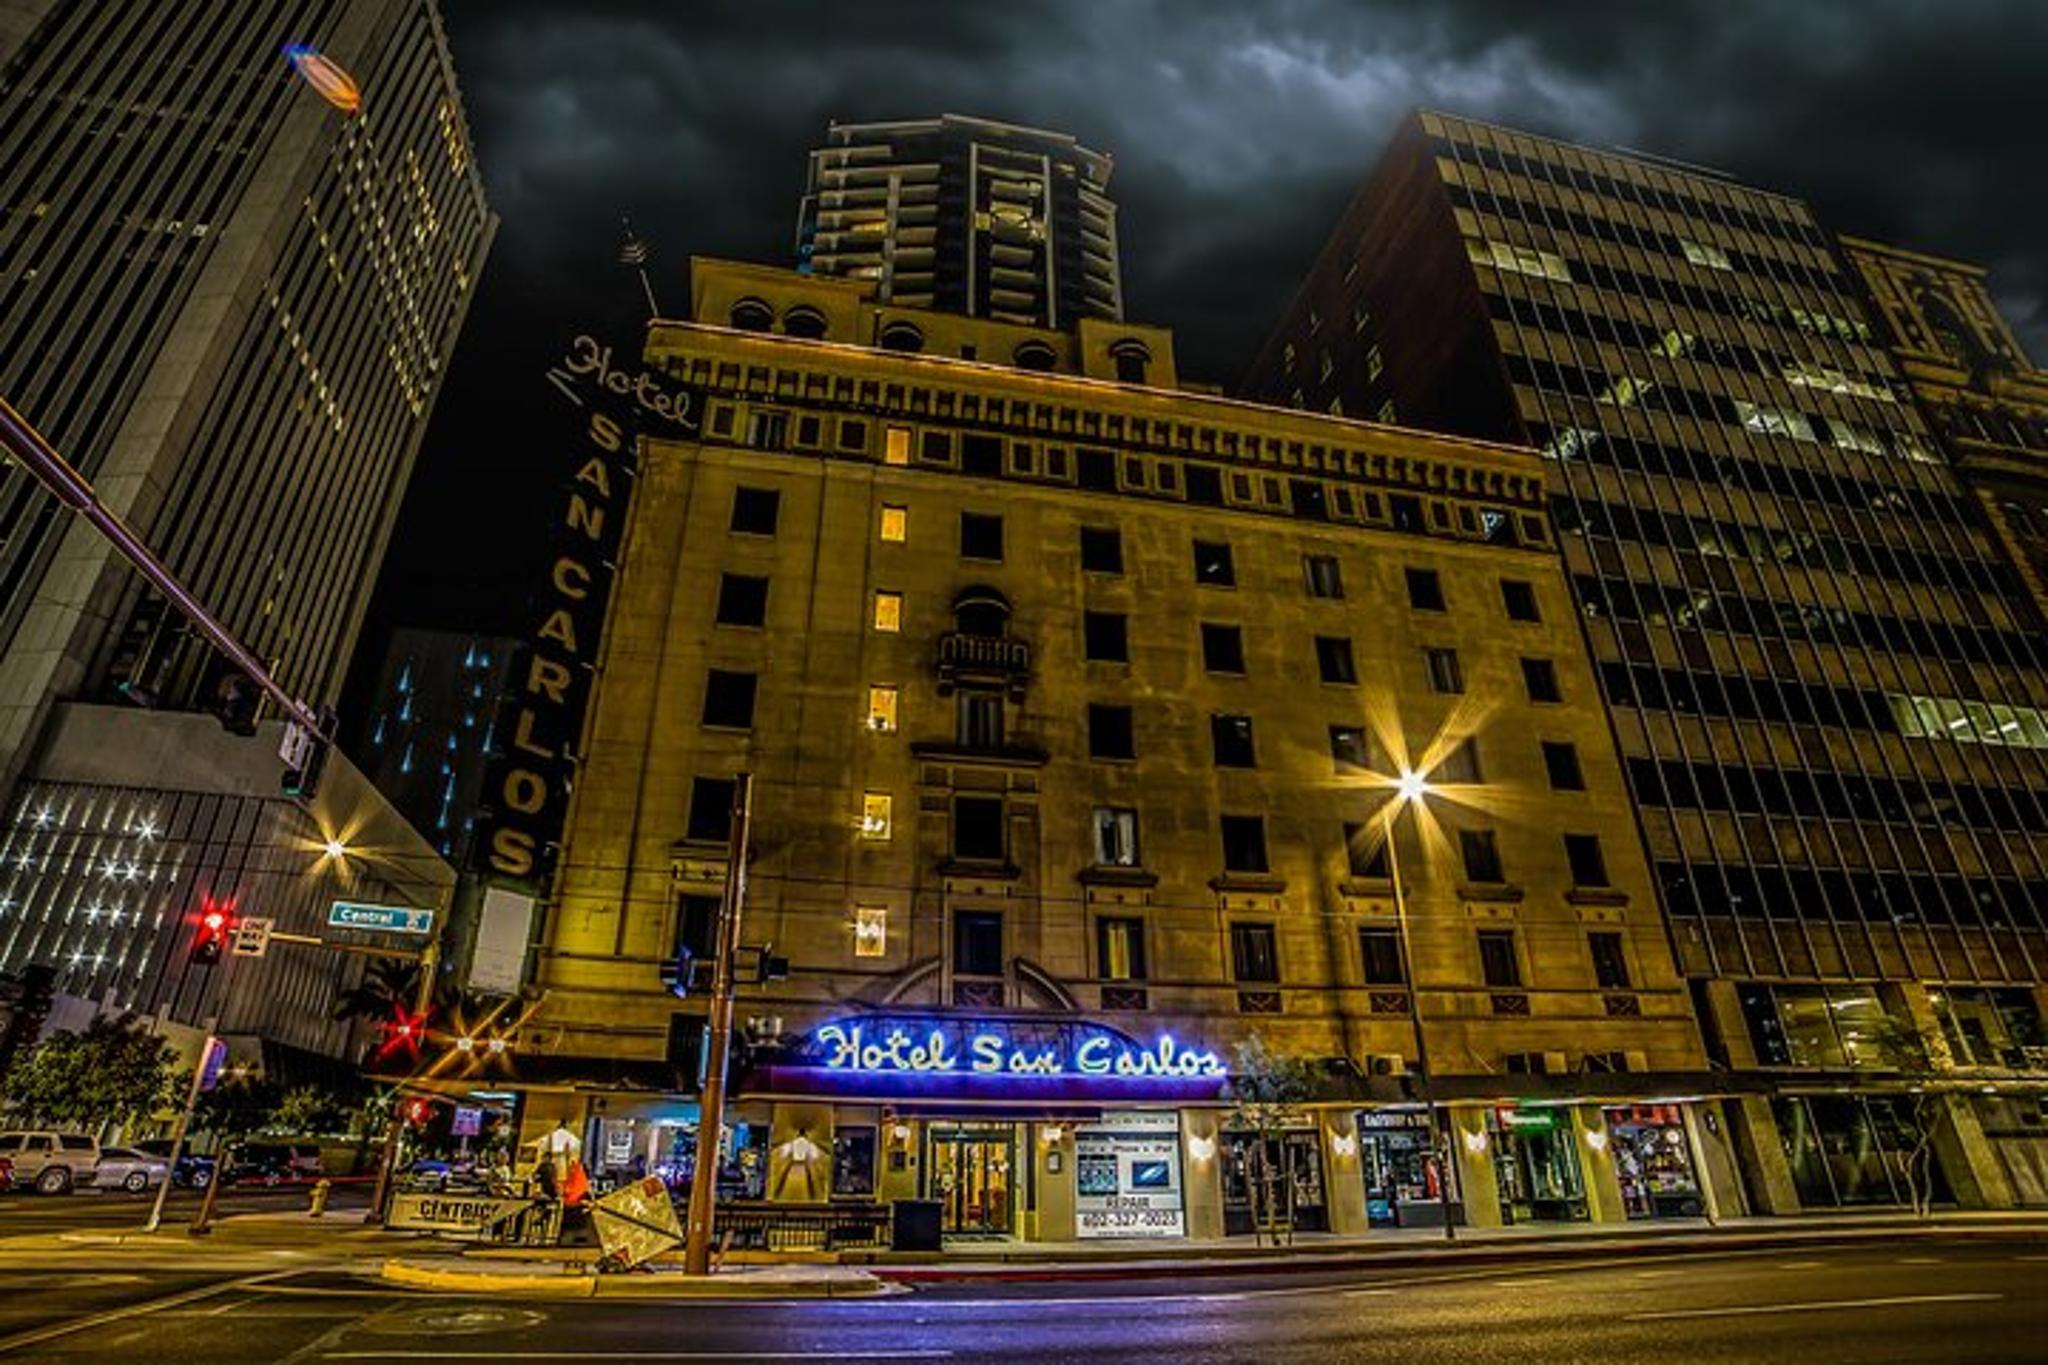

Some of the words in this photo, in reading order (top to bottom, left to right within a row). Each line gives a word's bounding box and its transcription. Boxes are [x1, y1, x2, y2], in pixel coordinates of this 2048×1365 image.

[565, 335, 698, 430] Hotel
[566, 412, 623, 541] SAN
[489, 556, 592, 877] CARLOS
[340, 908, 394, 924] Central
[818, 1025, 956, 1071] Hotel
[971, 1034, 1063, 1074] San
[1078, 1033, 1228, 1076] Carlos
[1105, 1196, 1151, 1209] REPAIR
